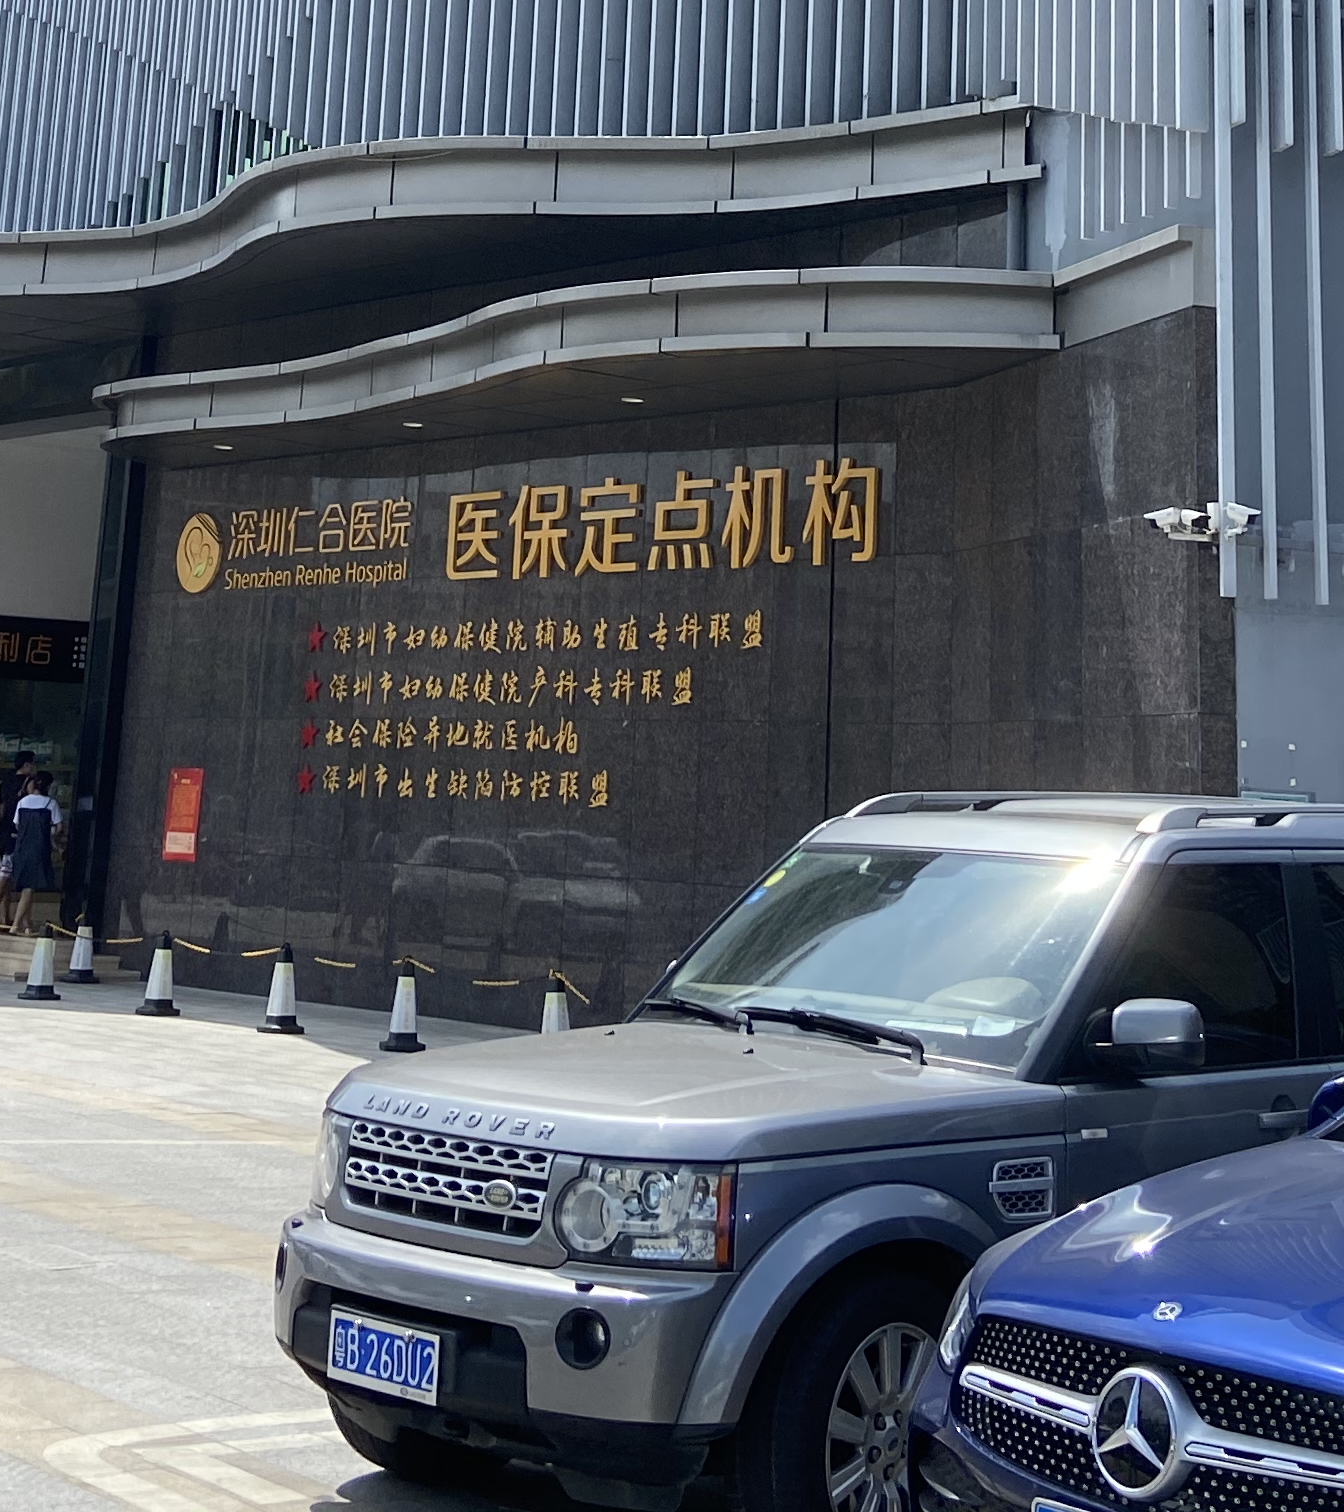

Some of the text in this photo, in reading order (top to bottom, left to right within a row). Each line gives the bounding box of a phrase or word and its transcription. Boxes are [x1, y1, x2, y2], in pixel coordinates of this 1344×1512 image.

[227, 495, 412, 560] 深圳仁合医院
[445, 457, 882, 580] 医保定点机构
[224, 557, 407, 590] Shenzhen Renhe Hospital
[333, 609, 763, 656] 深圳市妇幼保健院辅助生殖专科联盟
[329, 665, 692, 707] 深圳市妇幼保健院产科专科联盟
[325, 715, 578, 754] 社会保险异地就医机构
[322, 763, 609, 808] 深圳市出生缺陷防控联盟
[363, 1094, 556, 1140] LAND ROVER
